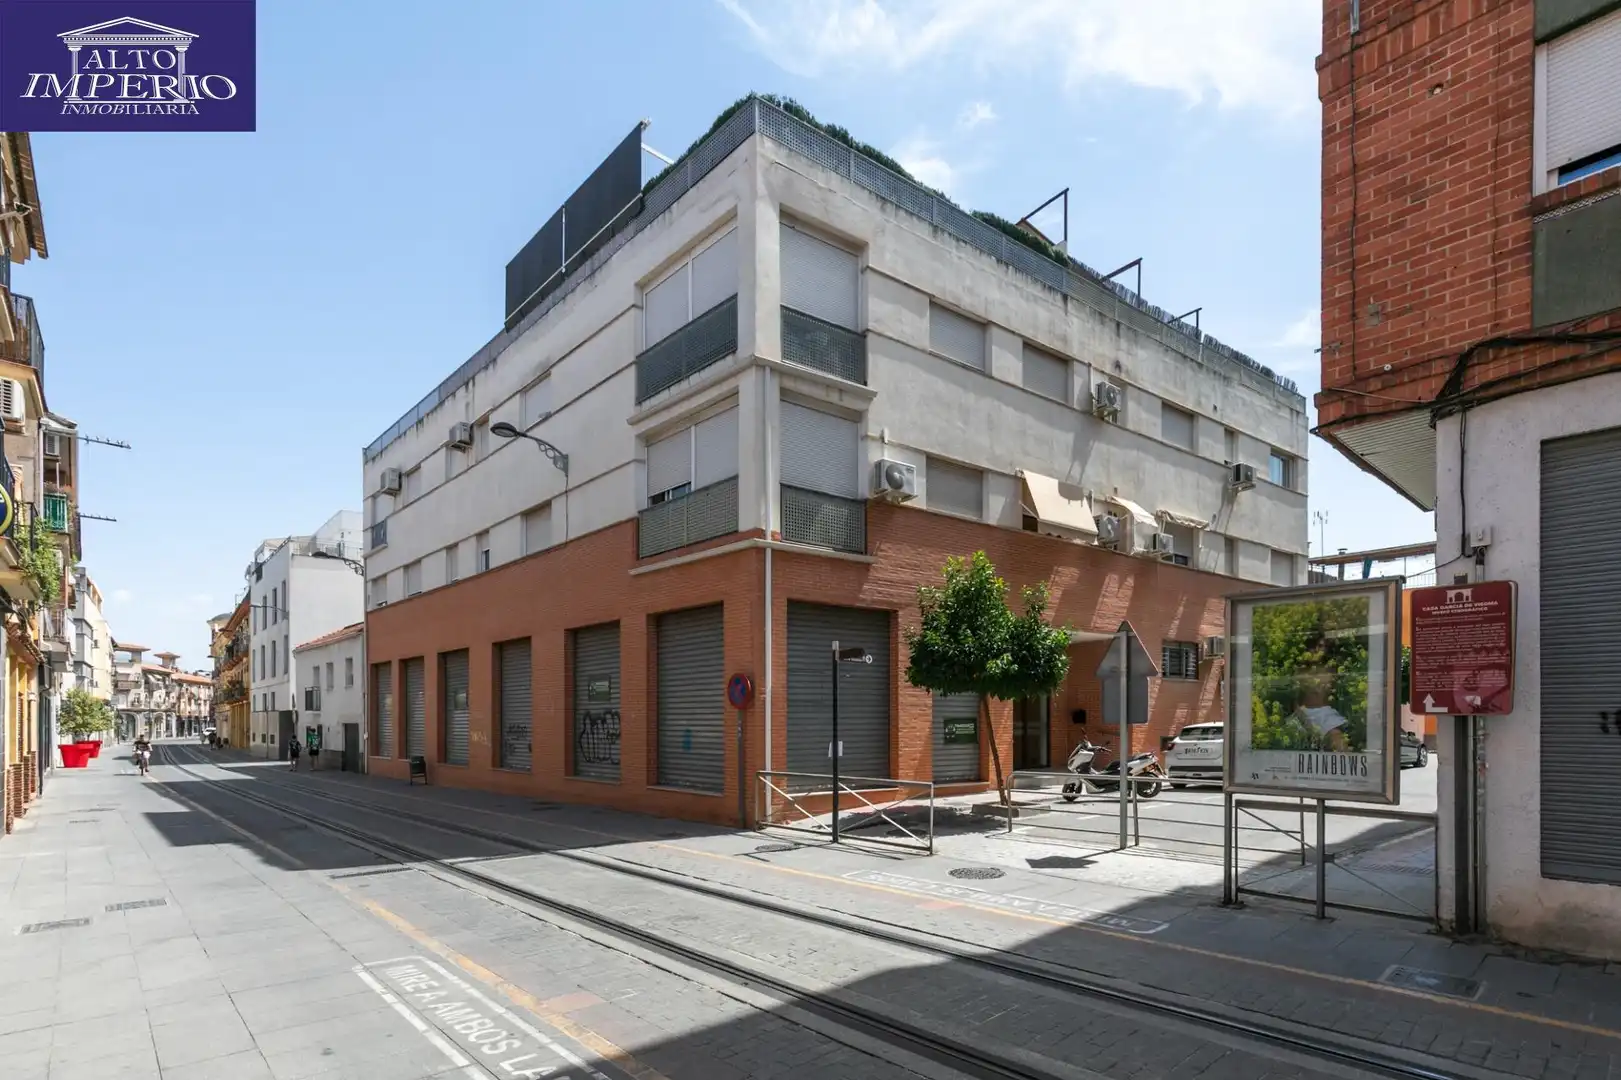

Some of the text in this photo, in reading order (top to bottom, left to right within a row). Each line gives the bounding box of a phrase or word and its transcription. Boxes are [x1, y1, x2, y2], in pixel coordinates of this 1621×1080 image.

[1298, 753, 1368, 777] RAINBOWS
[385, 964, 441, 993] MIRE
[414, 991, 449, 1003] A
[427, 1001, 523, 1056] AMBOS
